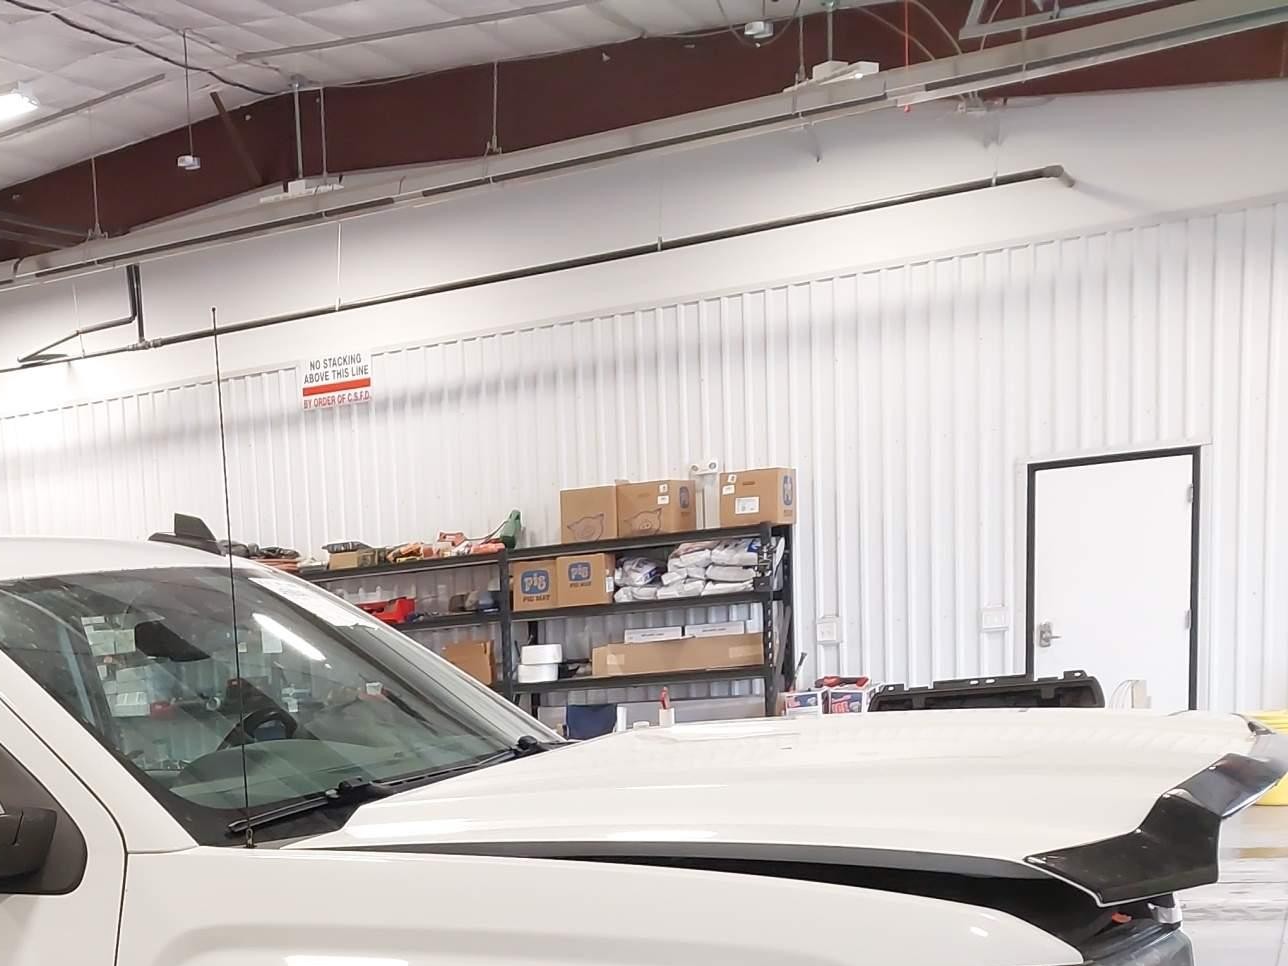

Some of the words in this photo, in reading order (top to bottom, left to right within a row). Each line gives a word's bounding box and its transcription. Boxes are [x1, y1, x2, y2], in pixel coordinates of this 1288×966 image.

[310, 359, 321, 370] NO
[323, 353, 362, 369] STACKING
[304, 371, 329, 384] ABOVE
[332, 367, 349, 379] THIS
[352, 364, 368, 376] LINE
[304, 399, 312, 409] BY
[314, 395, 336, 407] ORDER
[337, 394, 346, 404] OF
